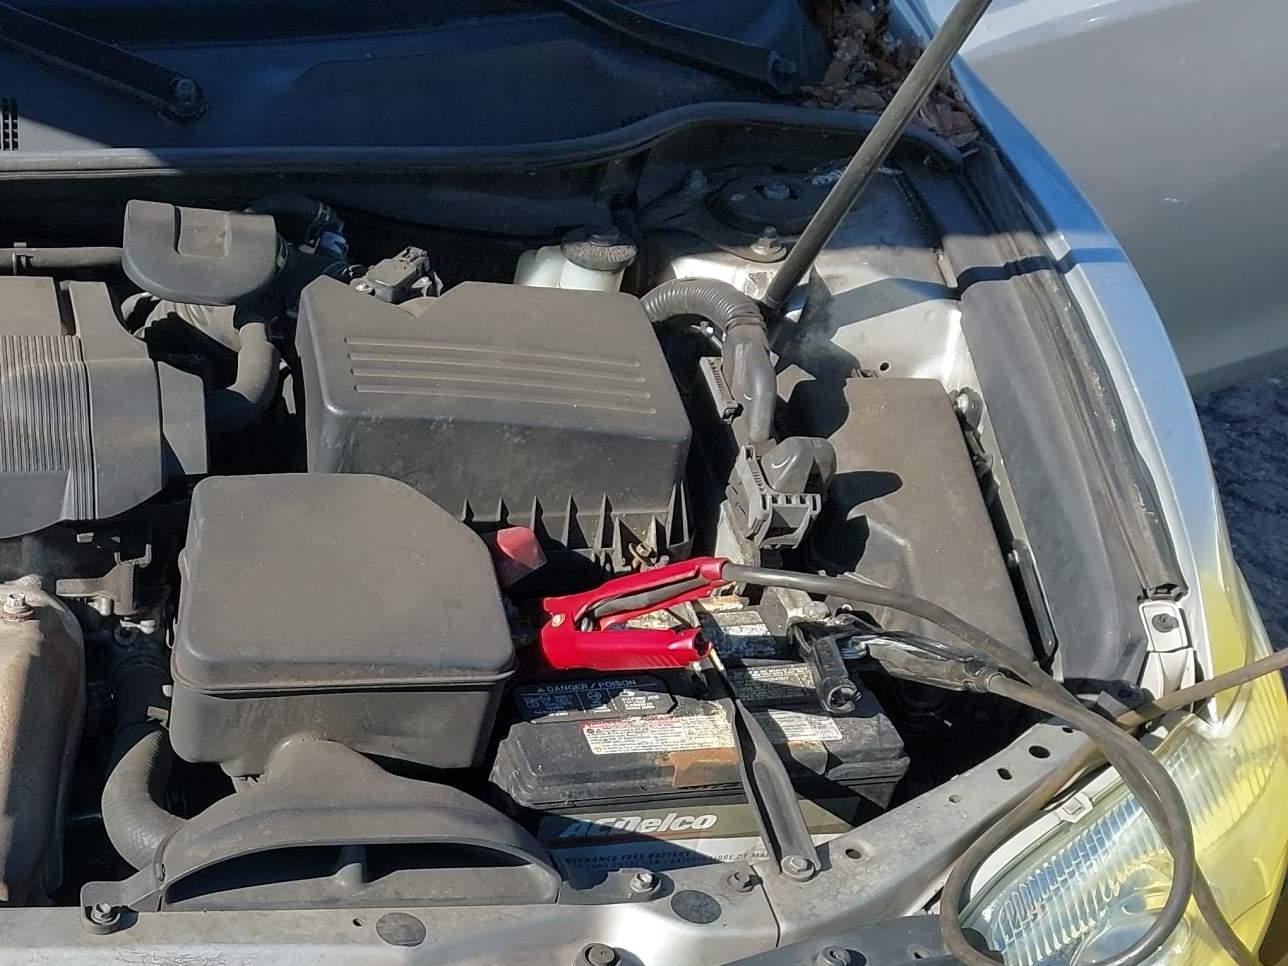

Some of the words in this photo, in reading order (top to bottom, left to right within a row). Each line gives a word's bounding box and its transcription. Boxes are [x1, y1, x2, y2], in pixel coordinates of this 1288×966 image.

[546, 681, 589, 693] DANGER
[598, 679, 637, 690] POISON
[559, 812, 718, 838] ACDelco
